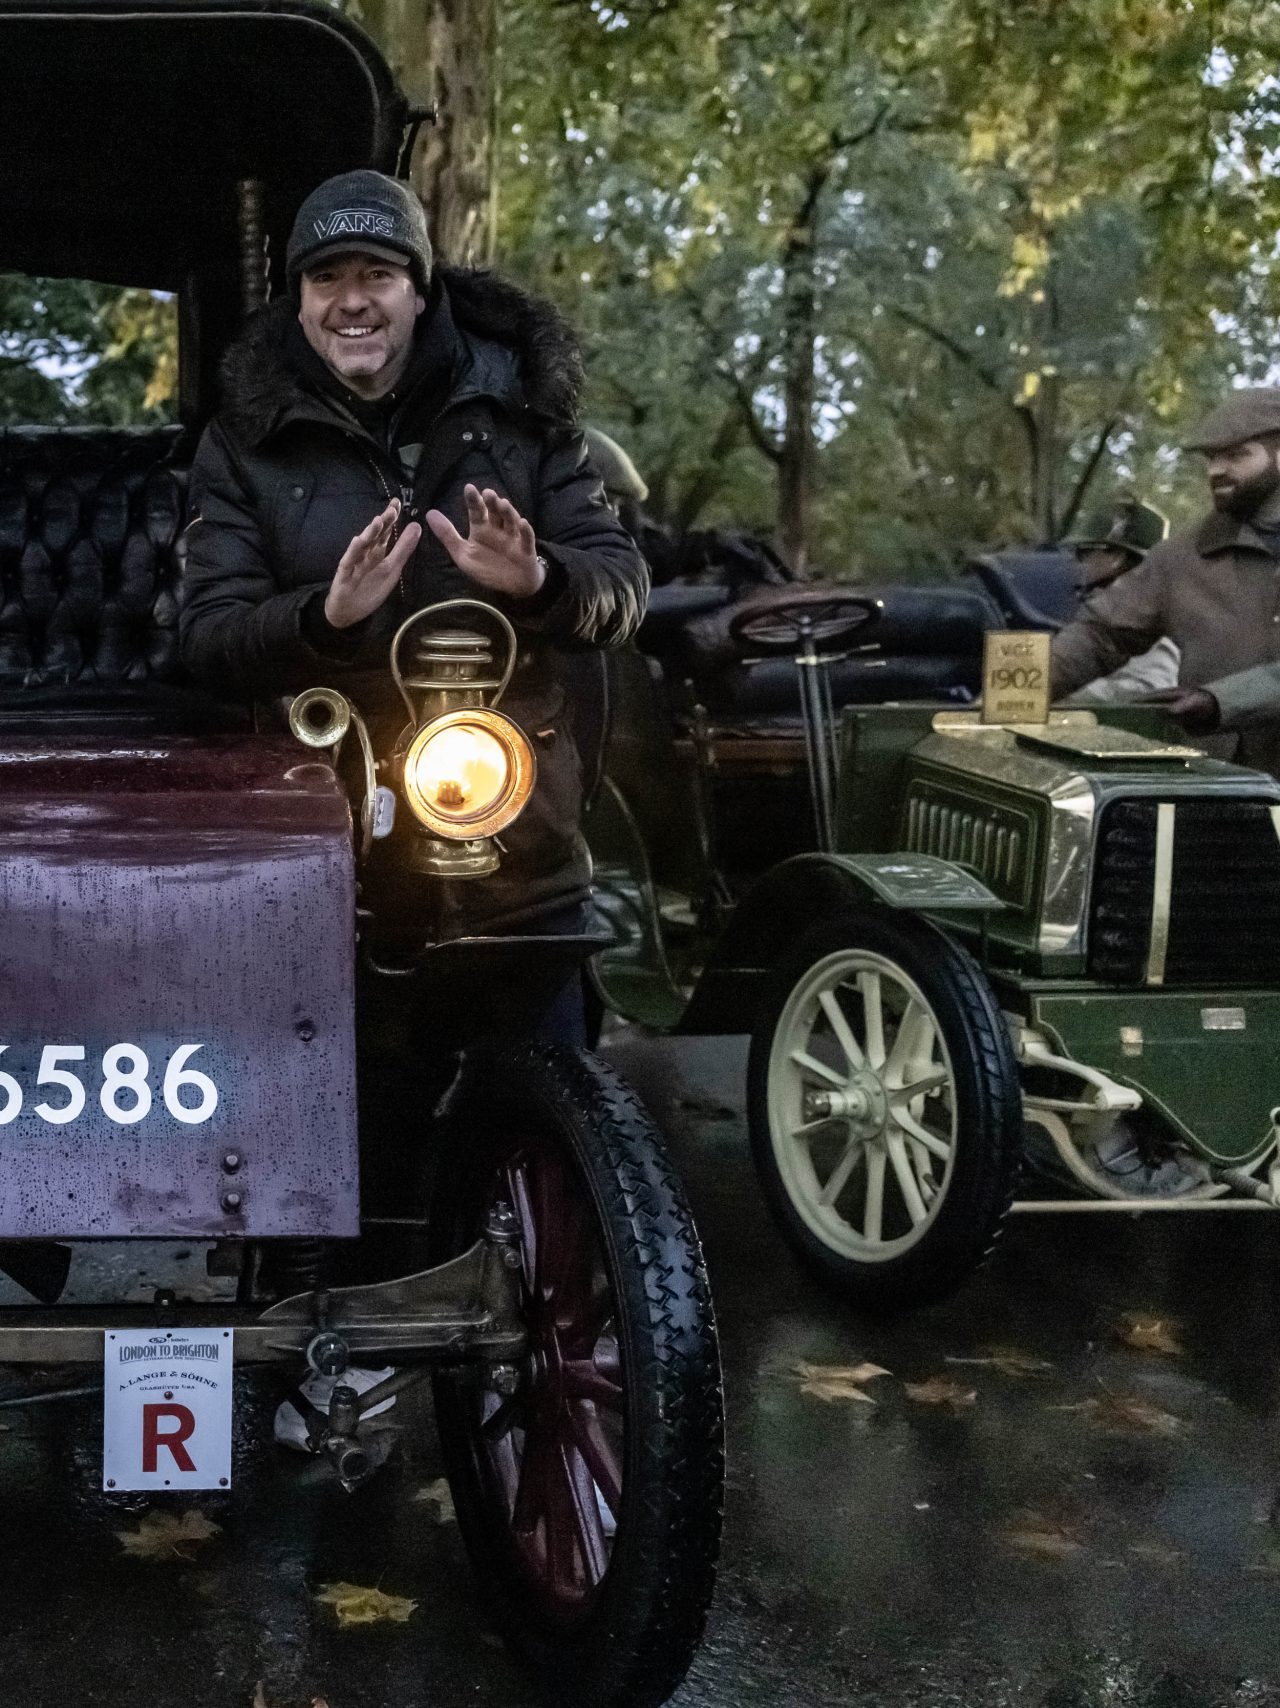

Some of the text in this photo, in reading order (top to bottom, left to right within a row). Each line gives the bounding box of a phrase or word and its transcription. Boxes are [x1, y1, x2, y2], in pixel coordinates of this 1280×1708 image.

[313, 207, 395, 239] VANS
[990, 667, 1042, 690] 1902
[120, 1344, 219, 1361] LONDON TO BRIGHTON
[128, 1371, 167, 1386] LANGE
[180, 1371, 218, 1389] SÖHNE
[142, 1403, 198, 1472] R
